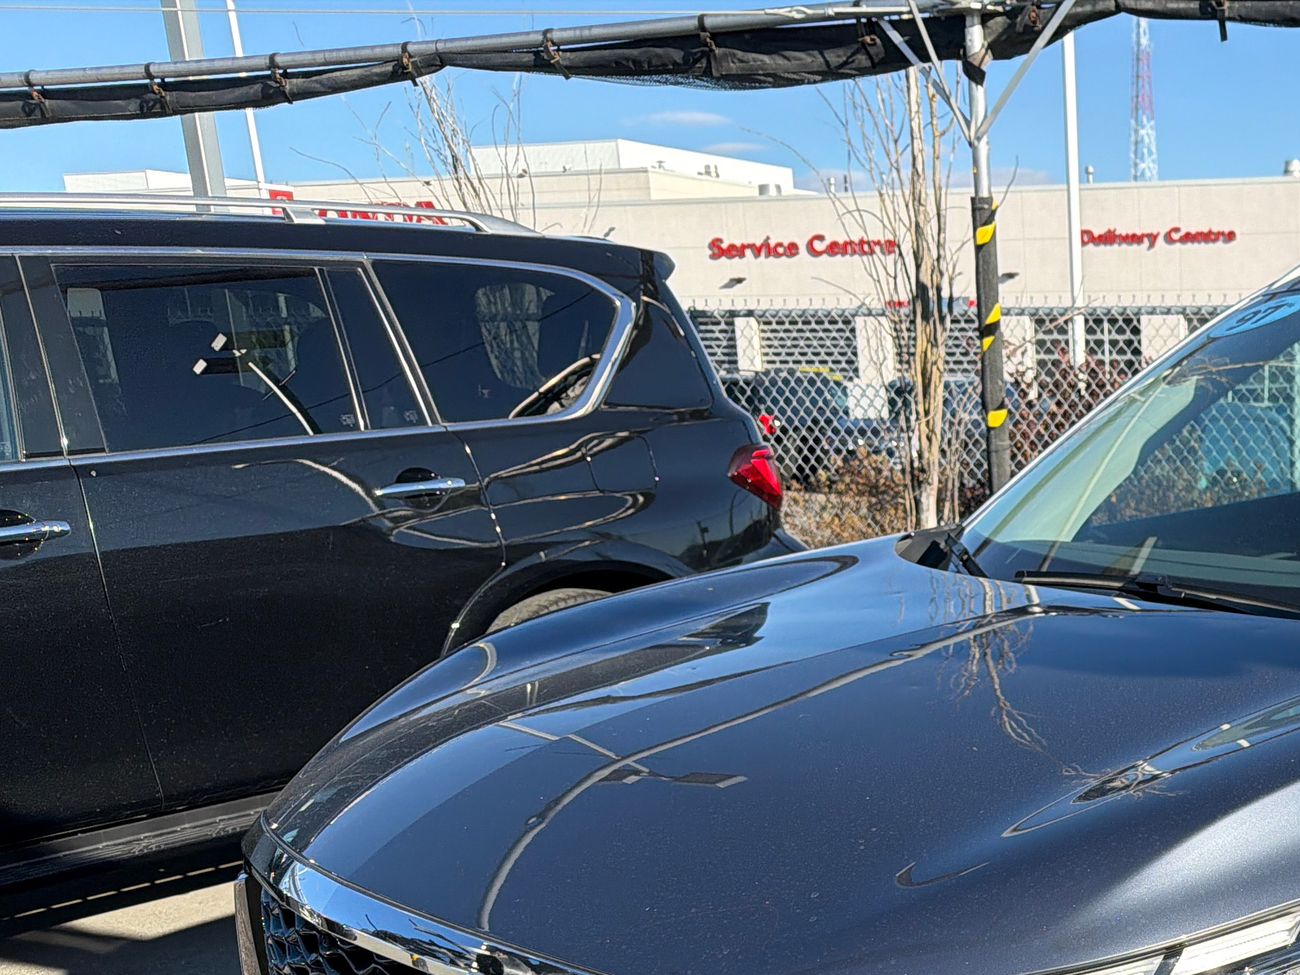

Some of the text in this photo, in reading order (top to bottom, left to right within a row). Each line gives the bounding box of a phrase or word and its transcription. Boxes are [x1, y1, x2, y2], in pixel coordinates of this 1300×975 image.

[708, 234, 896, 260] Service Centre
[1081, 227, 1236, 250] Delivery Centre
